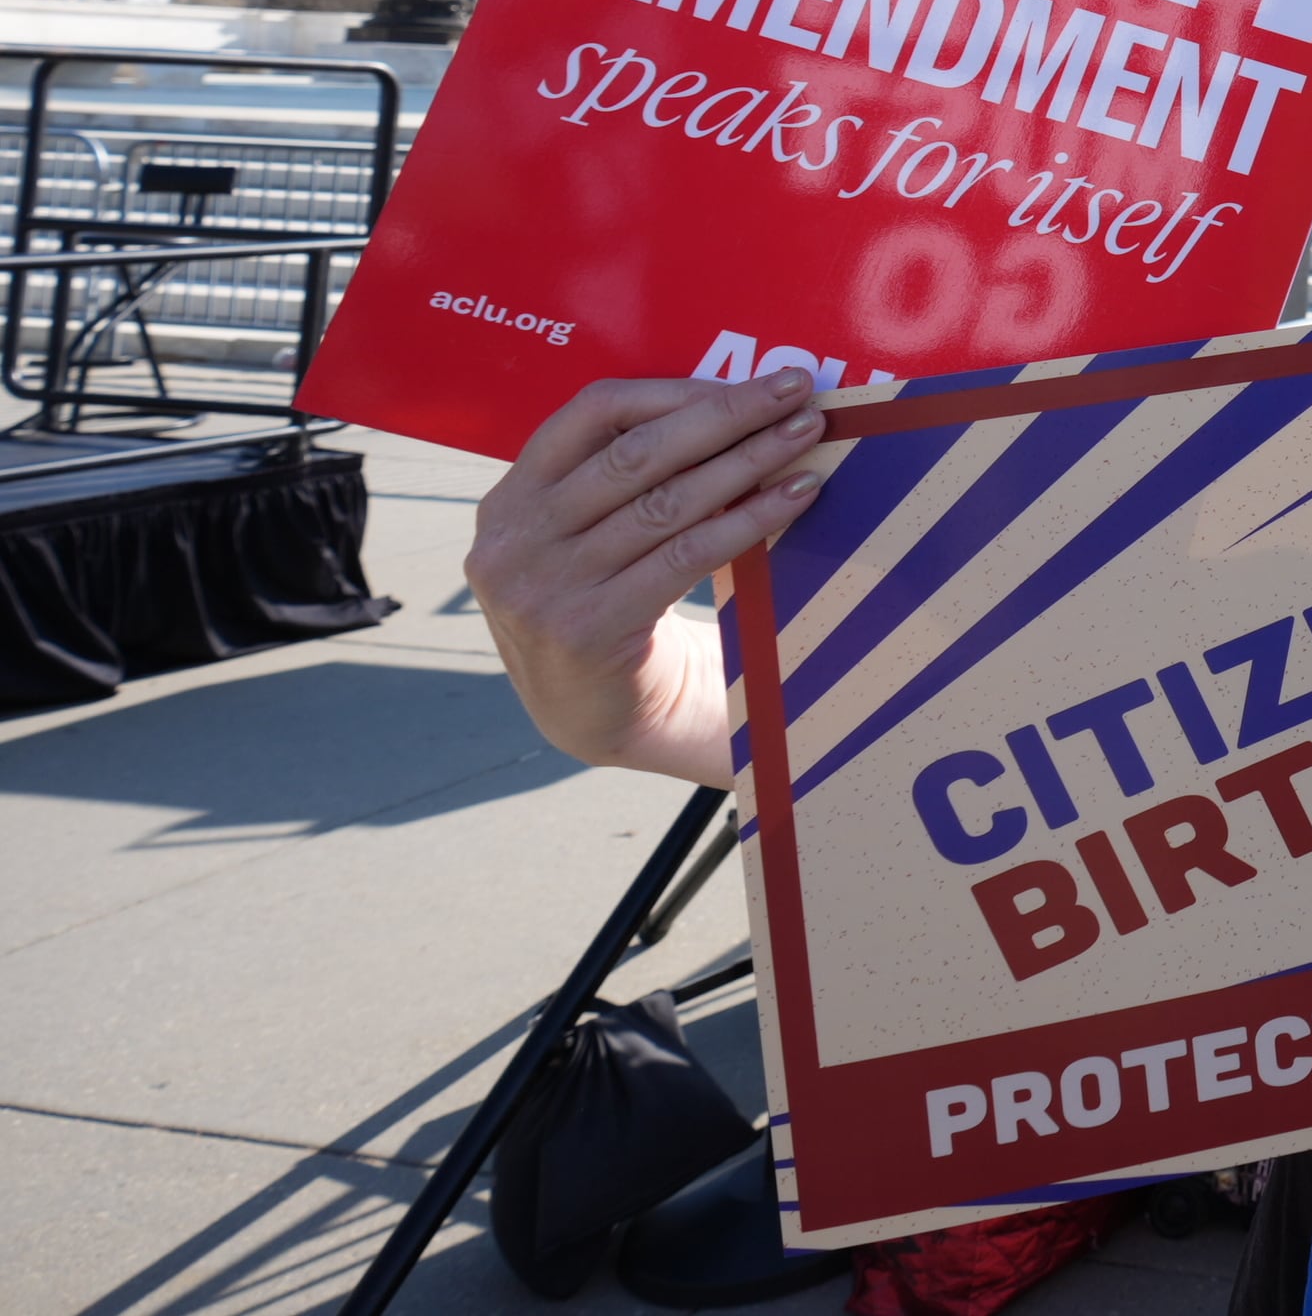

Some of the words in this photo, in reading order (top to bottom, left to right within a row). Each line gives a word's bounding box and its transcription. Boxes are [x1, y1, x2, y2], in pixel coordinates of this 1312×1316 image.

[537, 41, 864, 171] speaks
[838, 116, 1013, 210] for
[1007, 152, 1243, 284] itself
[429, 290, 577, 346] aclu.org
[689, 329, 895, 394] AC
